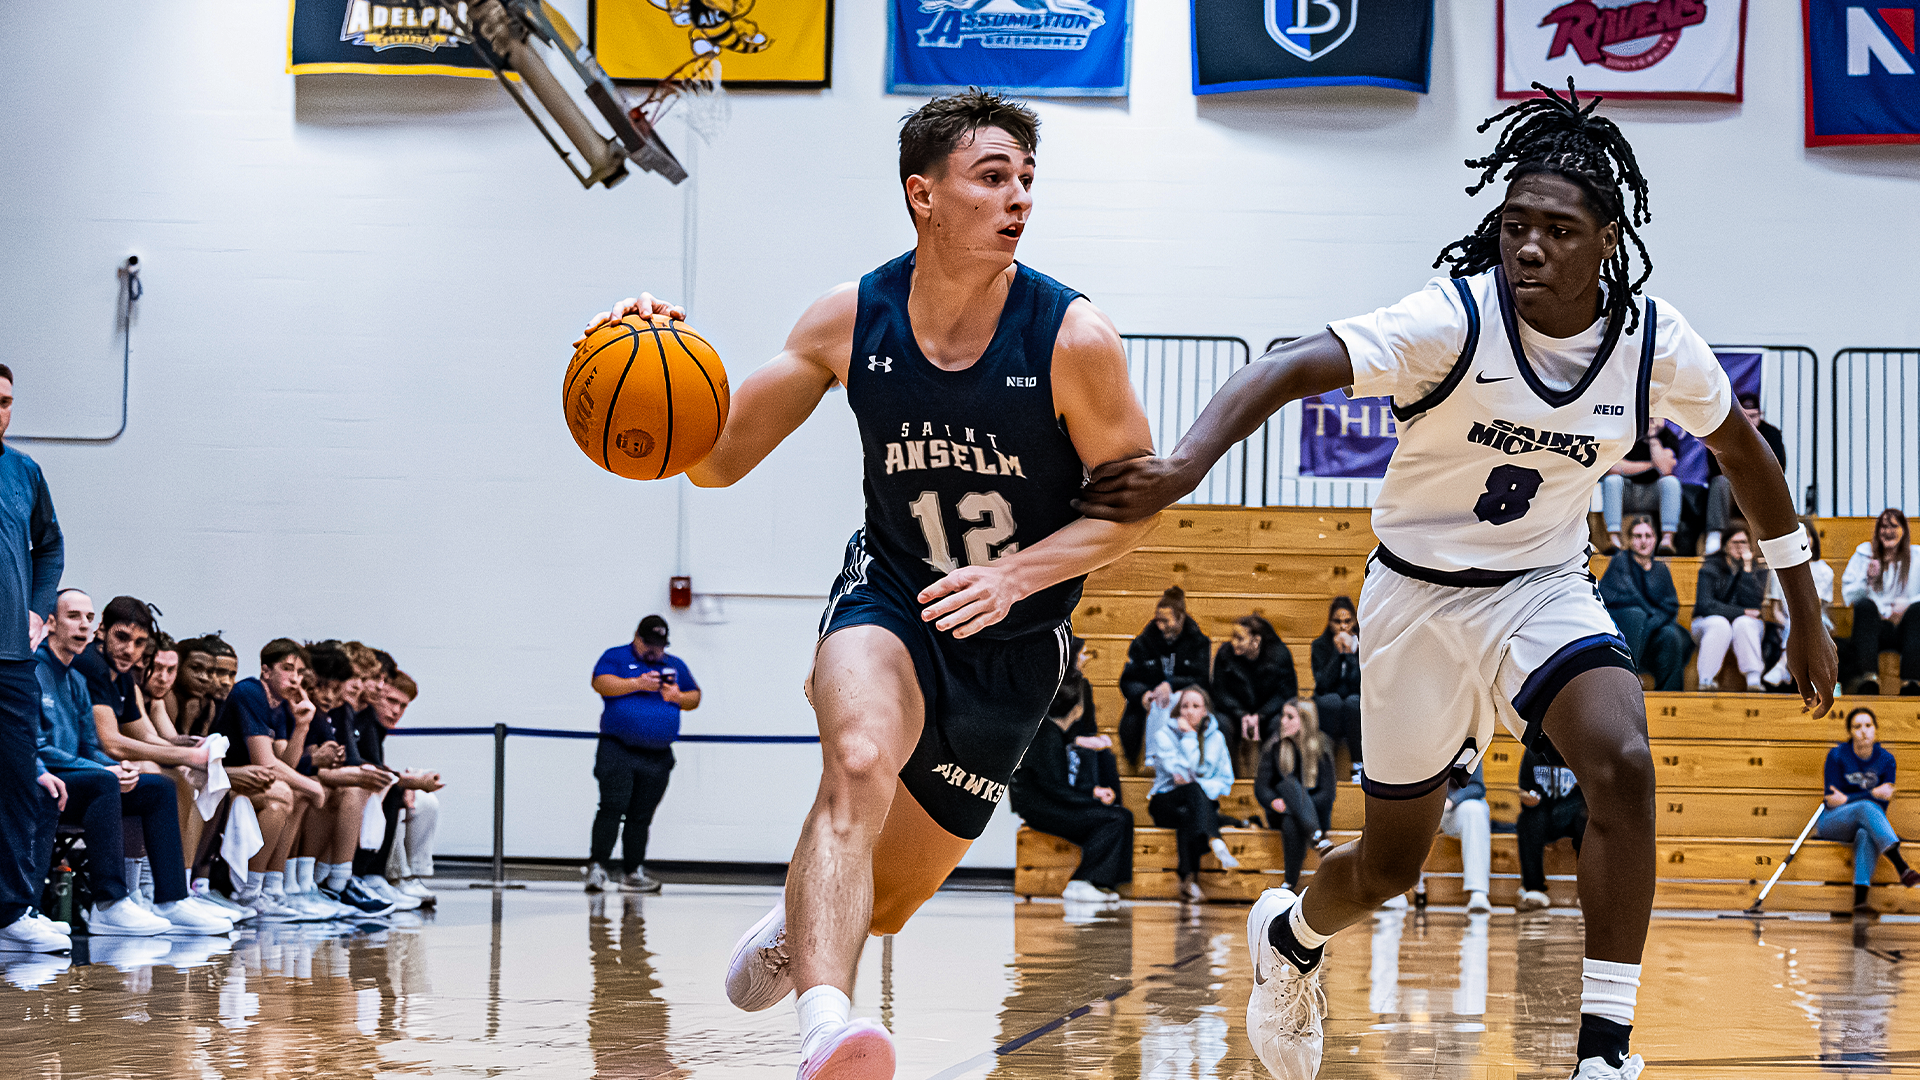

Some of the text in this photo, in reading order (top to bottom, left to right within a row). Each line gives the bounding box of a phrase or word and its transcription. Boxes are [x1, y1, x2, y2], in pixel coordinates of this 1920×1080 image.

[698, 10, 725, 26] AIC
[918, 10, 1092, 46] ASSUMPTION
[585, 366, 597, 388] NXT
[1006, 376, 1037, 388] NE10
[1306, 403, 1397, 438] THE
[1593, 404, 1625, 416] NE10
[901, 421, 997, 449] SAINT
[885, 439, 1028, 480] ANSELM
[1473, 463, 1544, 526] 8
[909, 490, 1020, 575] 12
